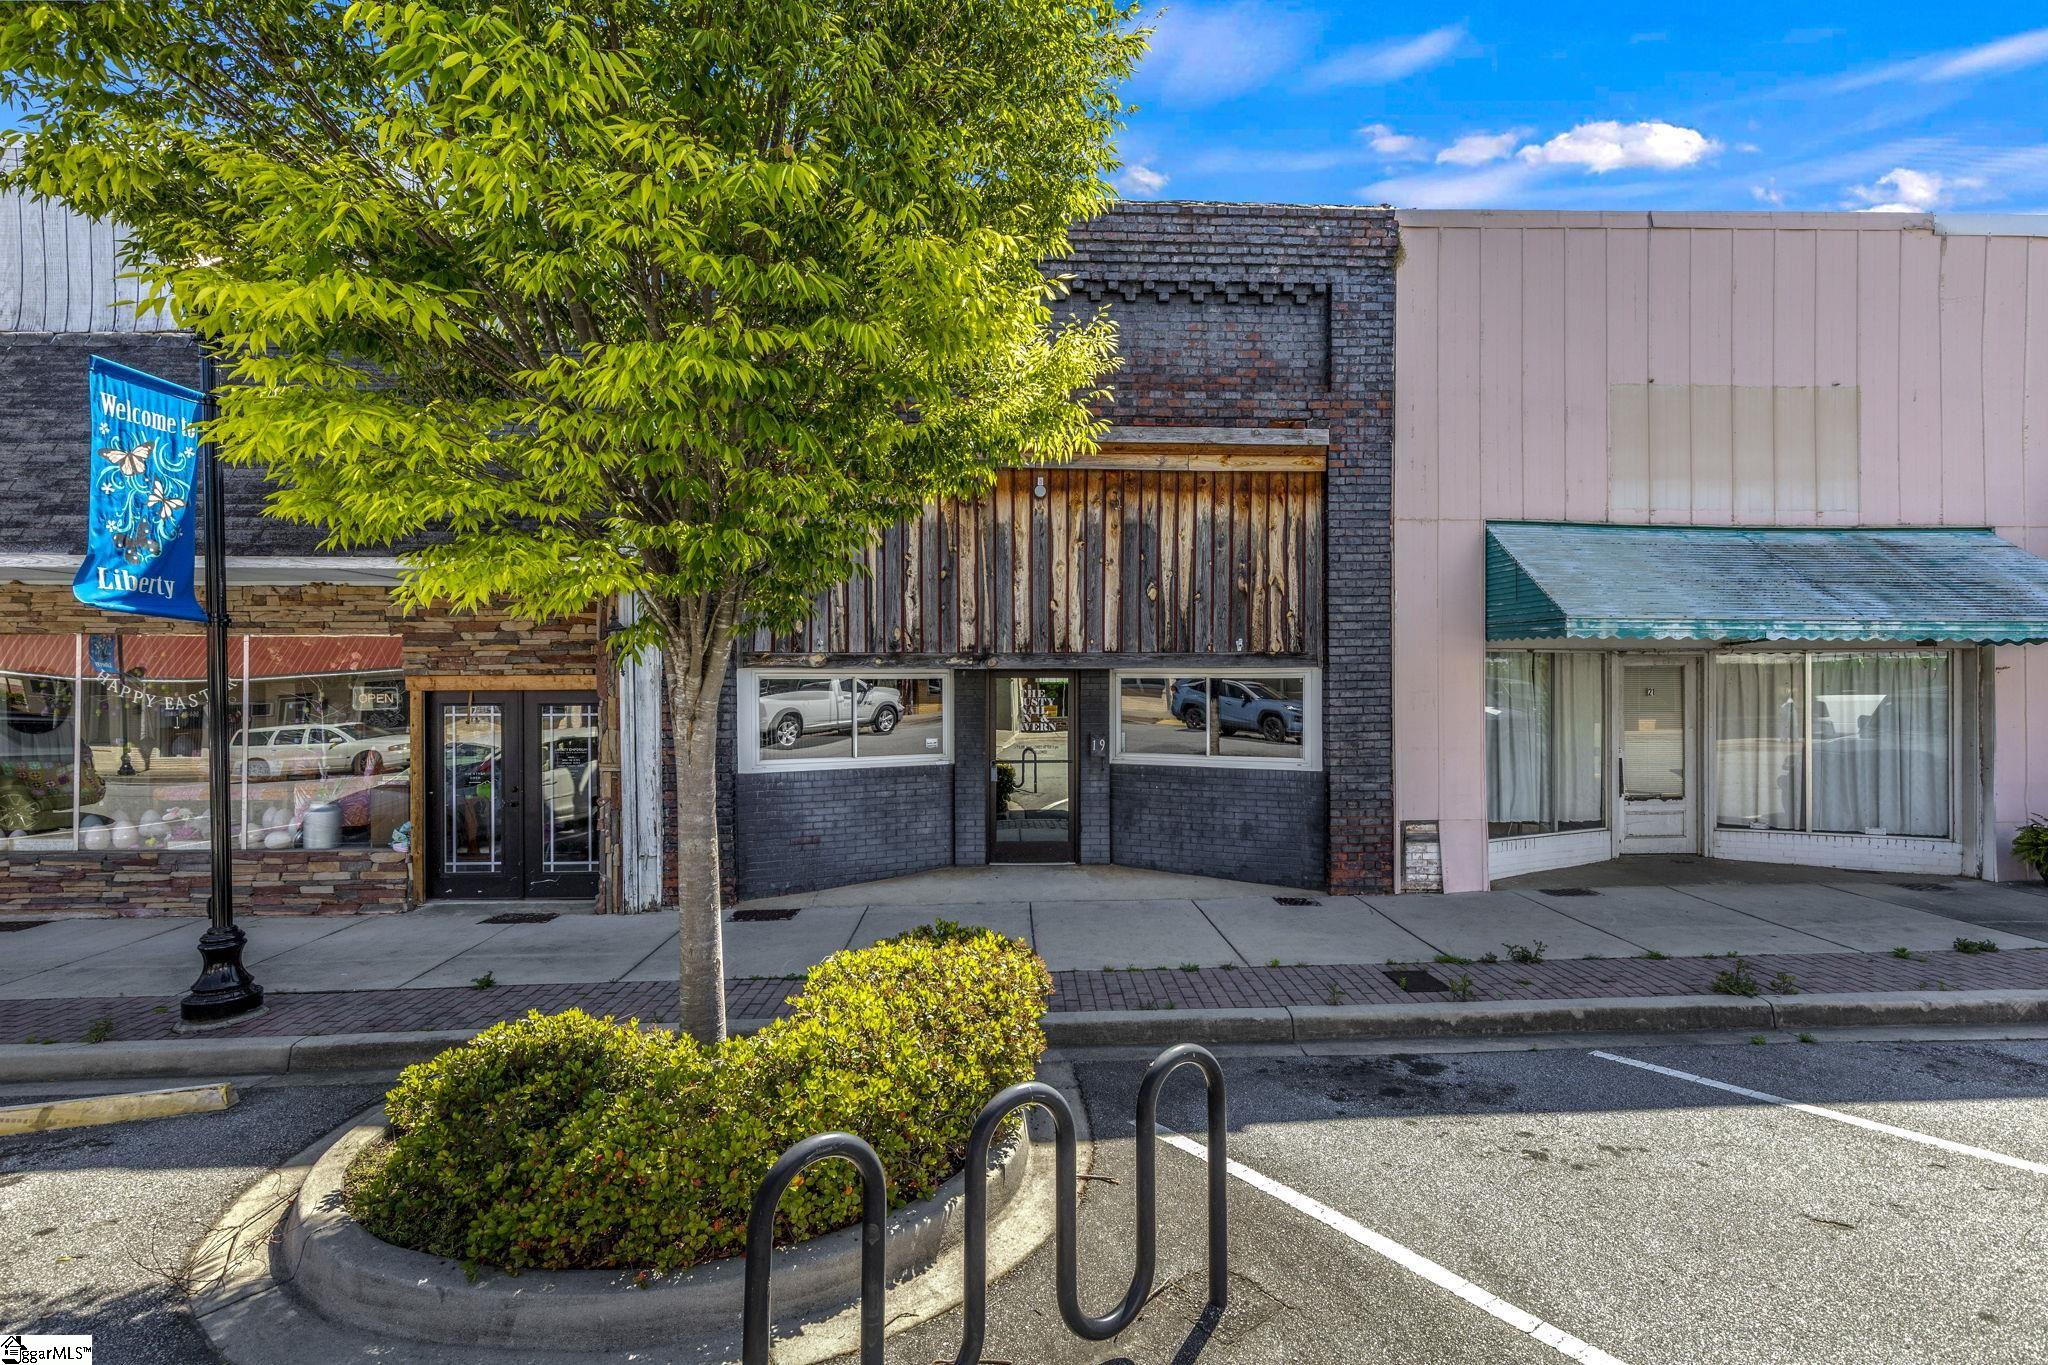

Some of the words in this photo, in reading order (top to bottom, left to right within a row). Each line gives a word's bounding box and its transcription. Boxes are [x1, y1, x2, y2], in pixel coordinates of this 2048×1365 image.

[100, 392, 177, 434] Welcome
[181, 416, 196, 439] to
[97, 566, 175, 599] Liberty
[96, 669, 157, 708] HAPPY
[165, 676, 238, 710] EASTR
[359, 693, 394, 704] OPEN
[1022, 697, 1055, 707] USTY
[1020, 723, 1057, 731] VERN
[1092, 739, 1105, 751] 19
